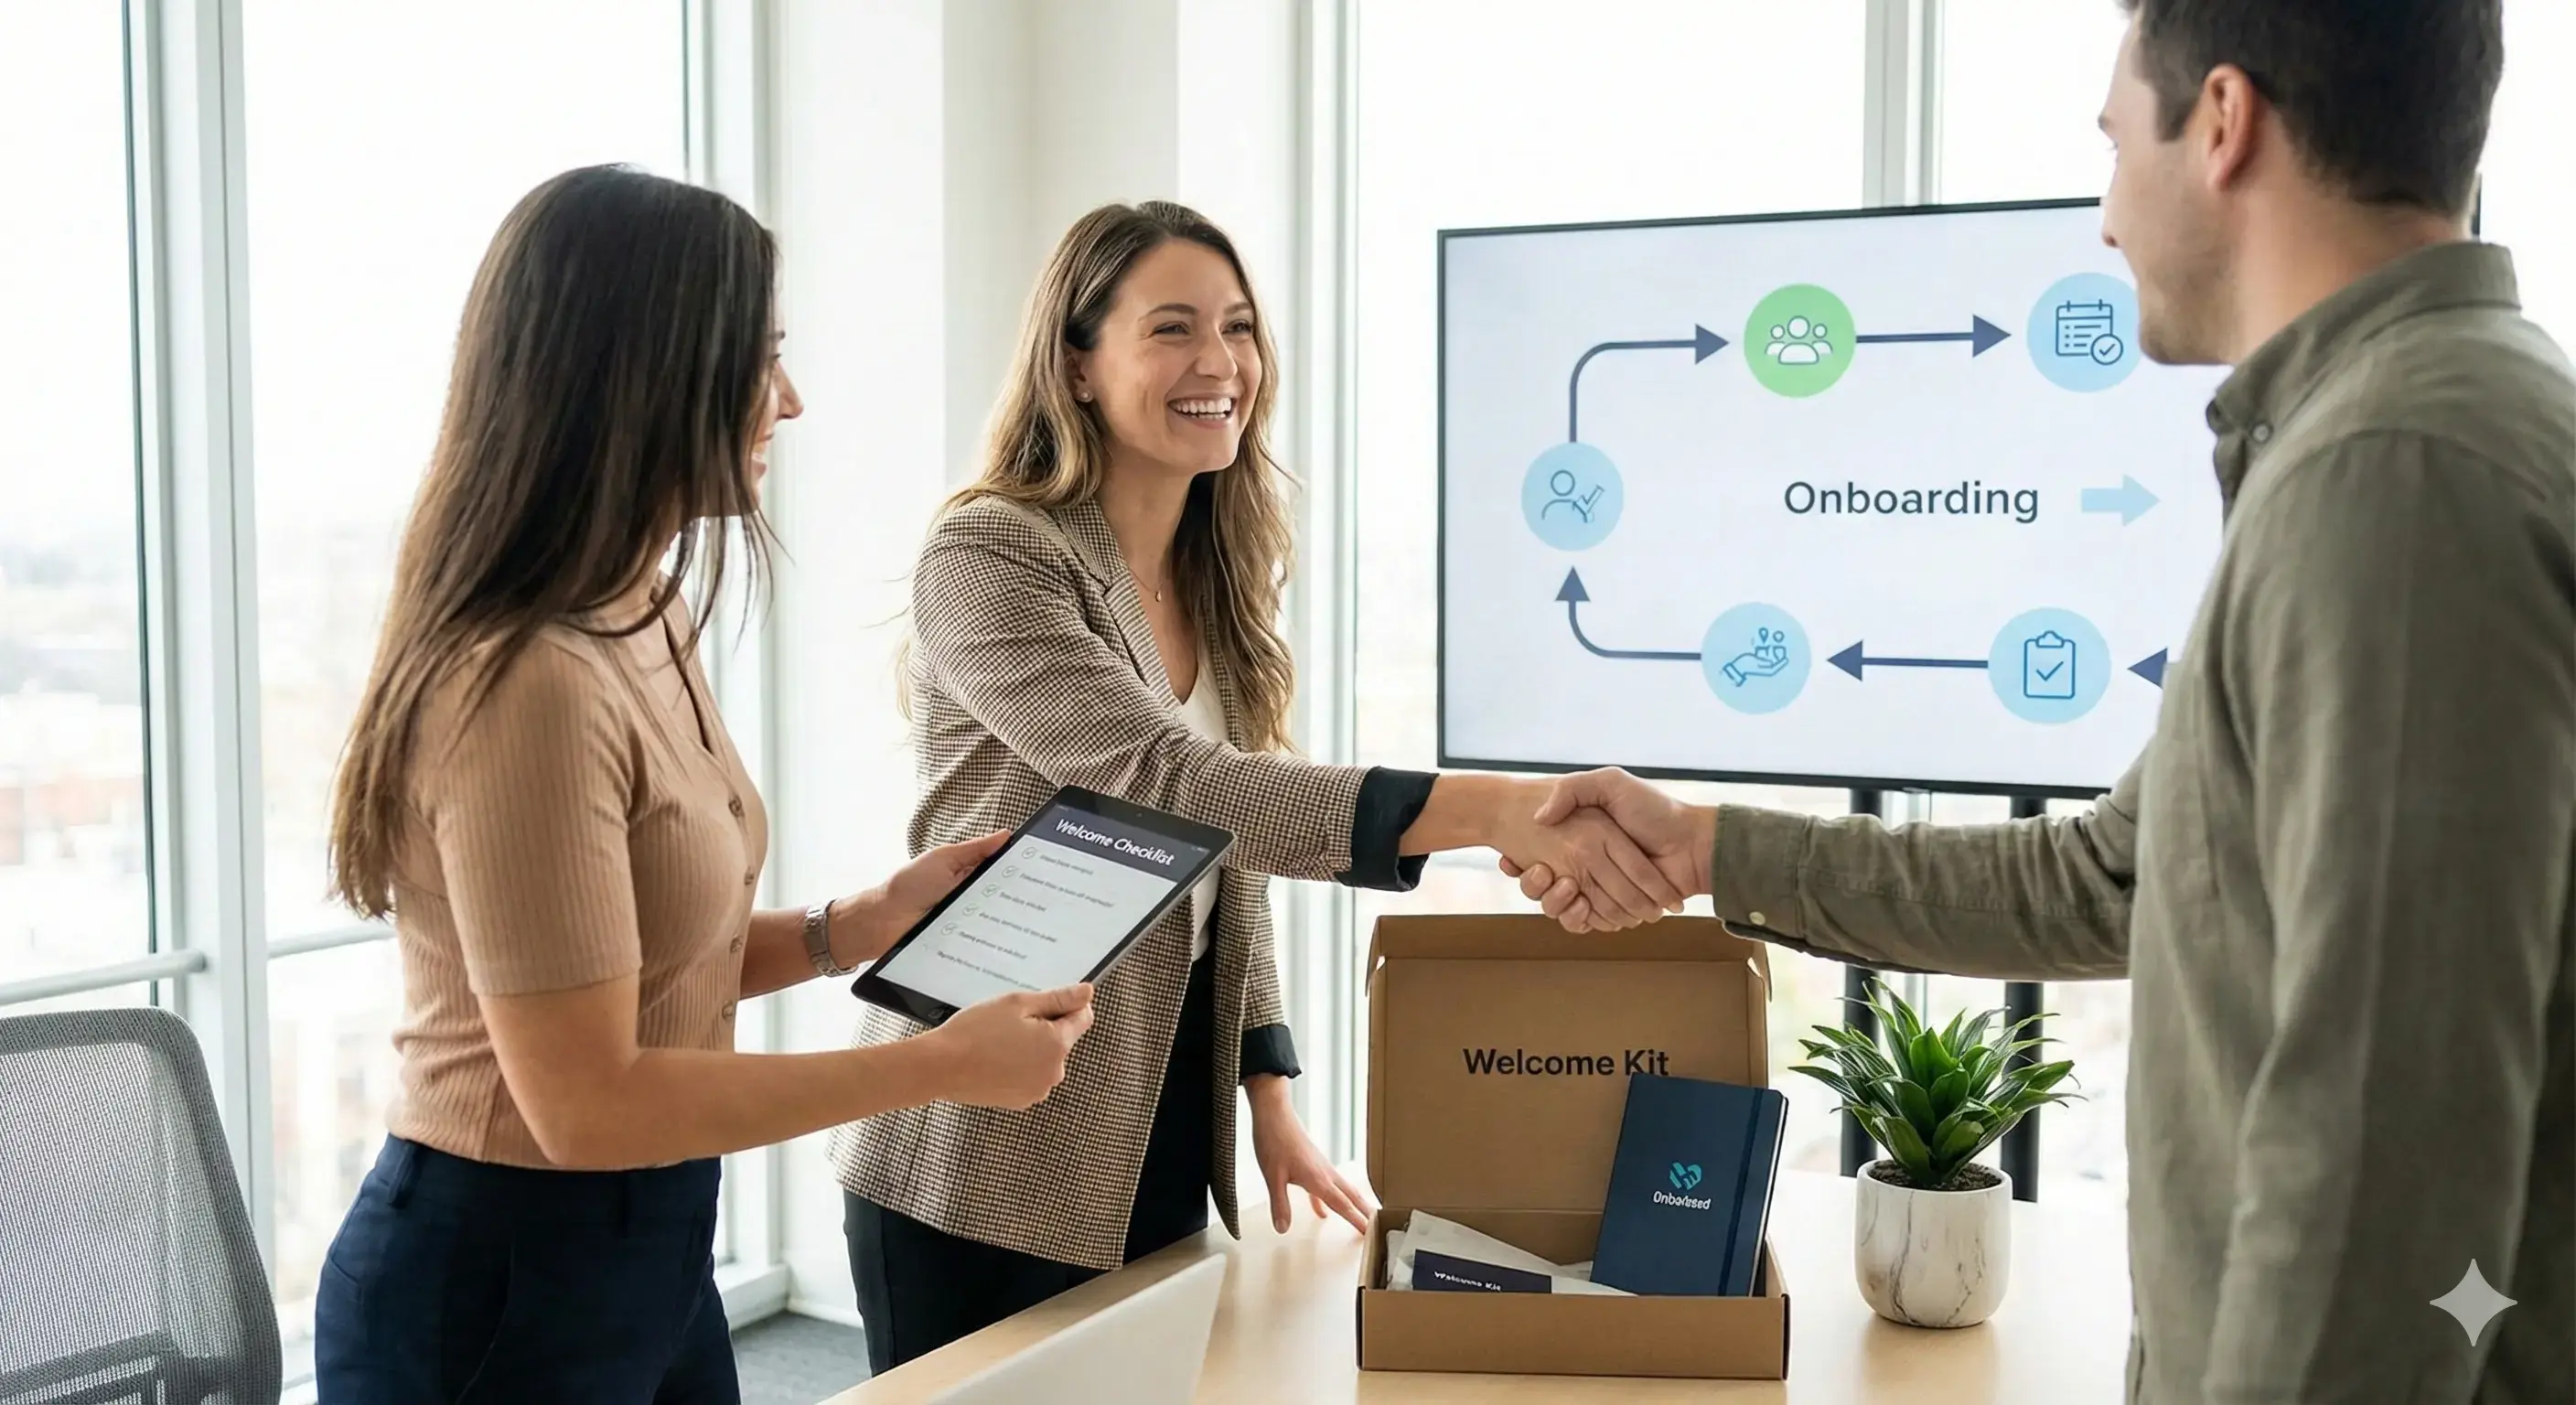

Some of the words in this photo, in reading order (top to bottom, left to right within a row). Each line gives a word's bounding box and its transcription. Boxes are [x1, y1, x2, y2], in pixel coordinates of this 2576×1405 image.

[1784, 480, 2038, 524] Onboarding
[1055, 819, 1114, 847] Welcome
[1113, 837, 1175, 866] Checklist
[1463, 1048, 1615, 1076] Welcome
[1624, 1049, 1669, 1076] Kit
